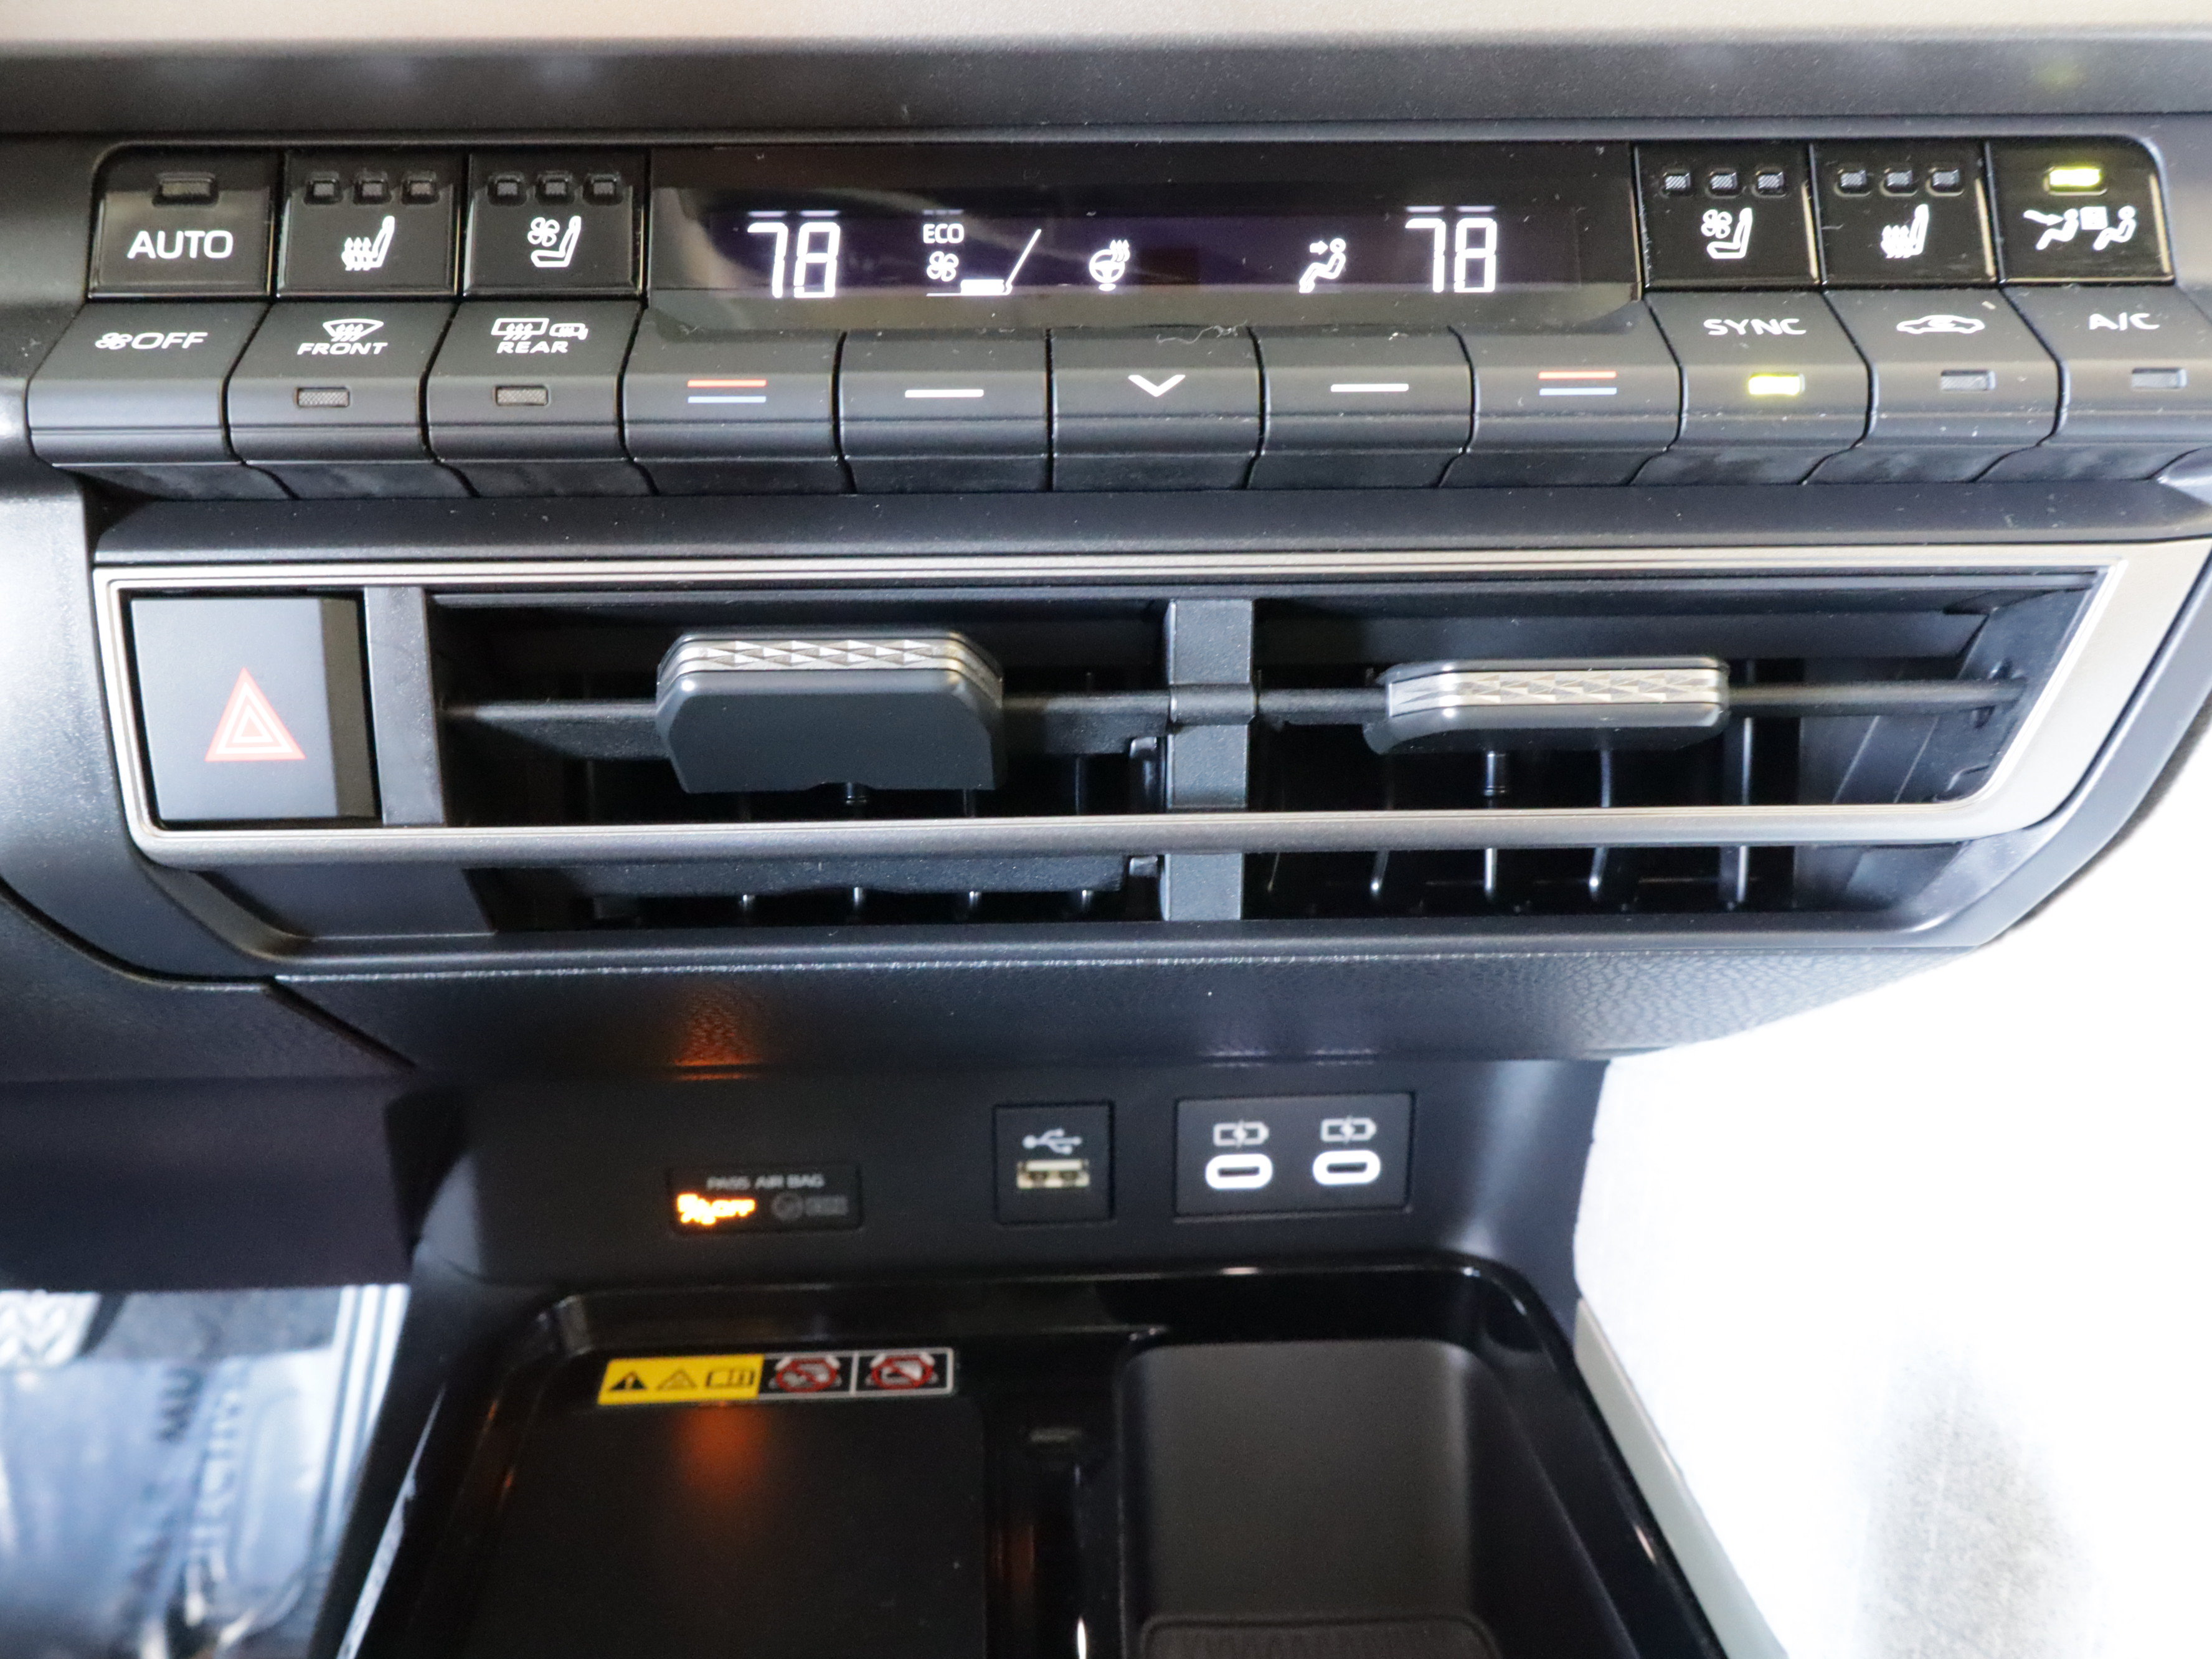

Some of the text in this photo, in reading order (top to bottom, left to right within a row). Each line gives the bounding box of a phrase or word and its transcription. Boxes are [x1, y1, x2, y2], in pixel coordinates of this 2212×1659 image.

[922, 222, 965, 244] ECO
[126, 229, 234, 260] AUTO
[747, 222, 841, 299] 78
[1405, 217, 1498, 293] 78
[1703, 318, 1807, 336] SYNC
[2087, 311, 2160, 331] A/C
[132, 331, 209, 350] OFF
[296, 341, 389, 356] FRONT
[496, 341, 569, 354] REAR
